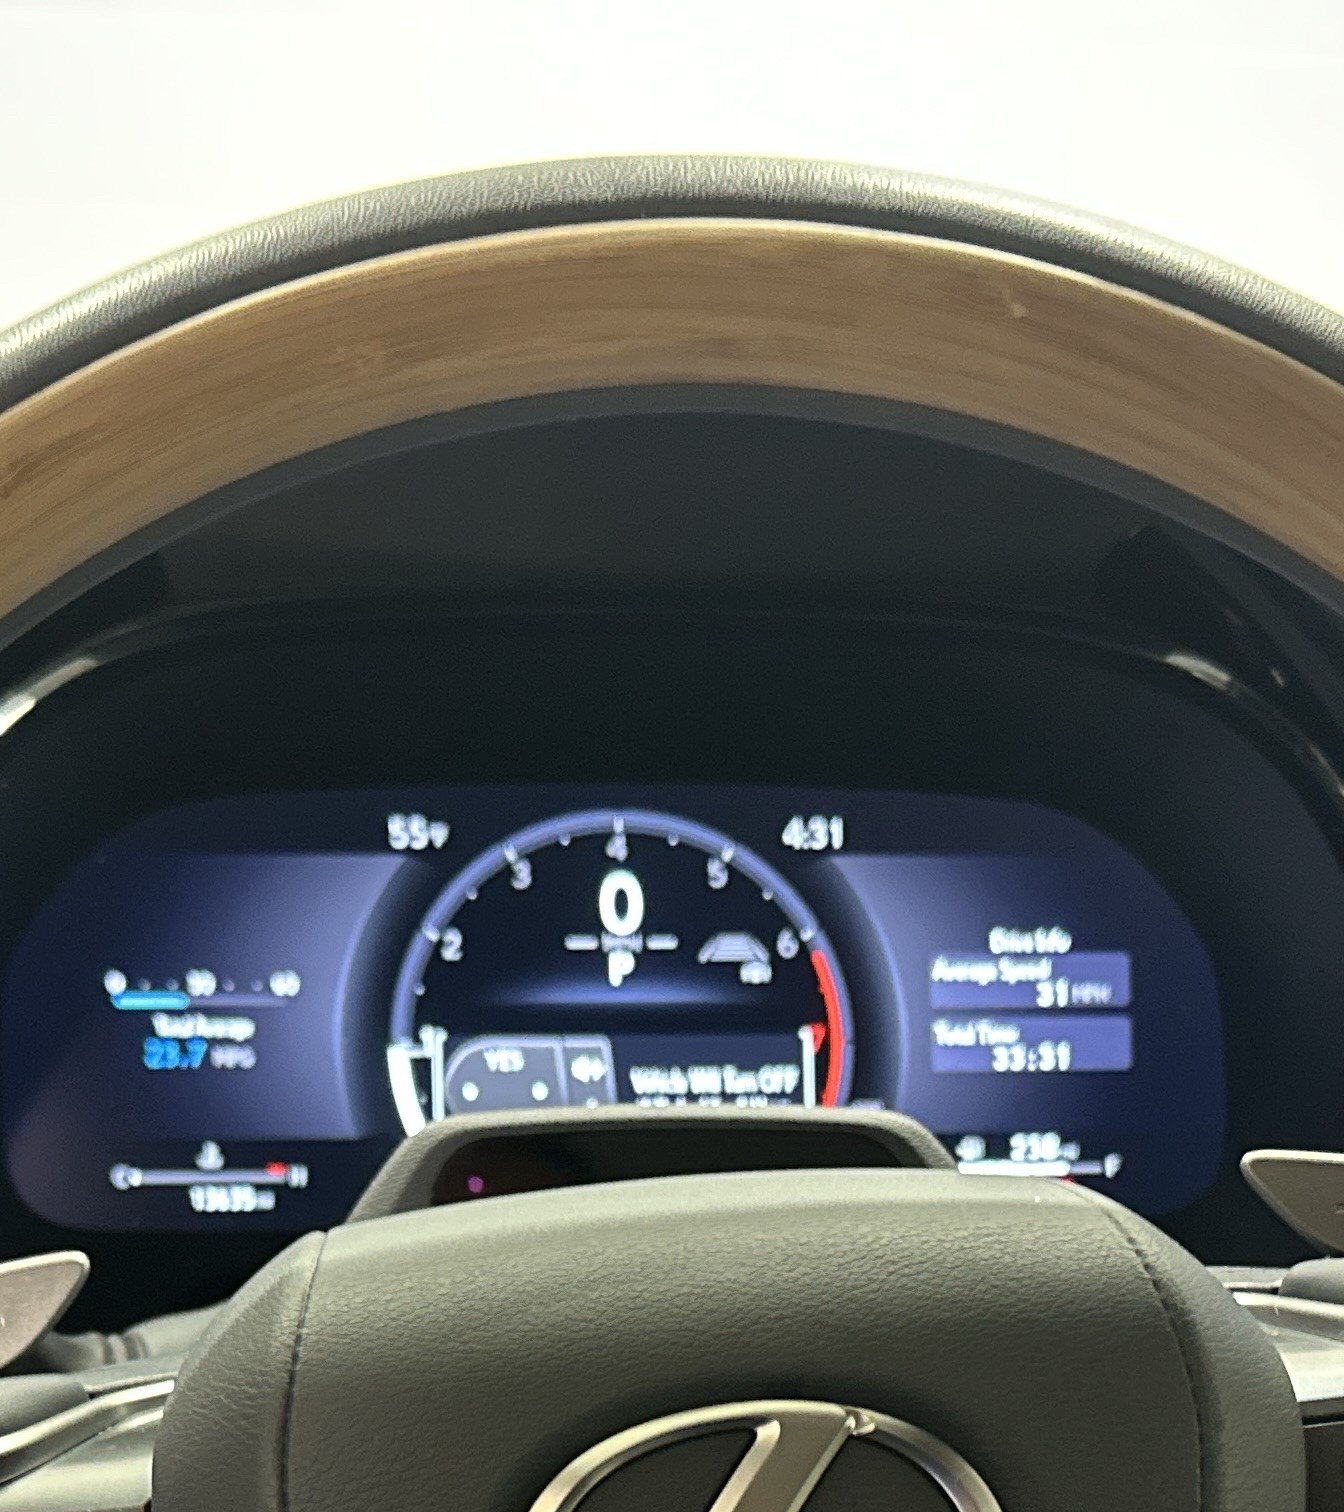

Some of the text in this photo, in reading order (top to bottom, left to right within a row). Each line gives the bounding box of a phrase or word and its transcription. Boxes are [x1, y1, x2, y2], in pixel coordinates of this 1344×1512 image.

[510, 858, 533, 890] 3
[707, 857, 729, 889] 5
[598, 869, 644, 937] 0
[440, 926, 463, 962] 2
[777, 927, 800, 960] 6
[607, 949, 636, 987] P
[1036, 977, 1069, 1008] 31
